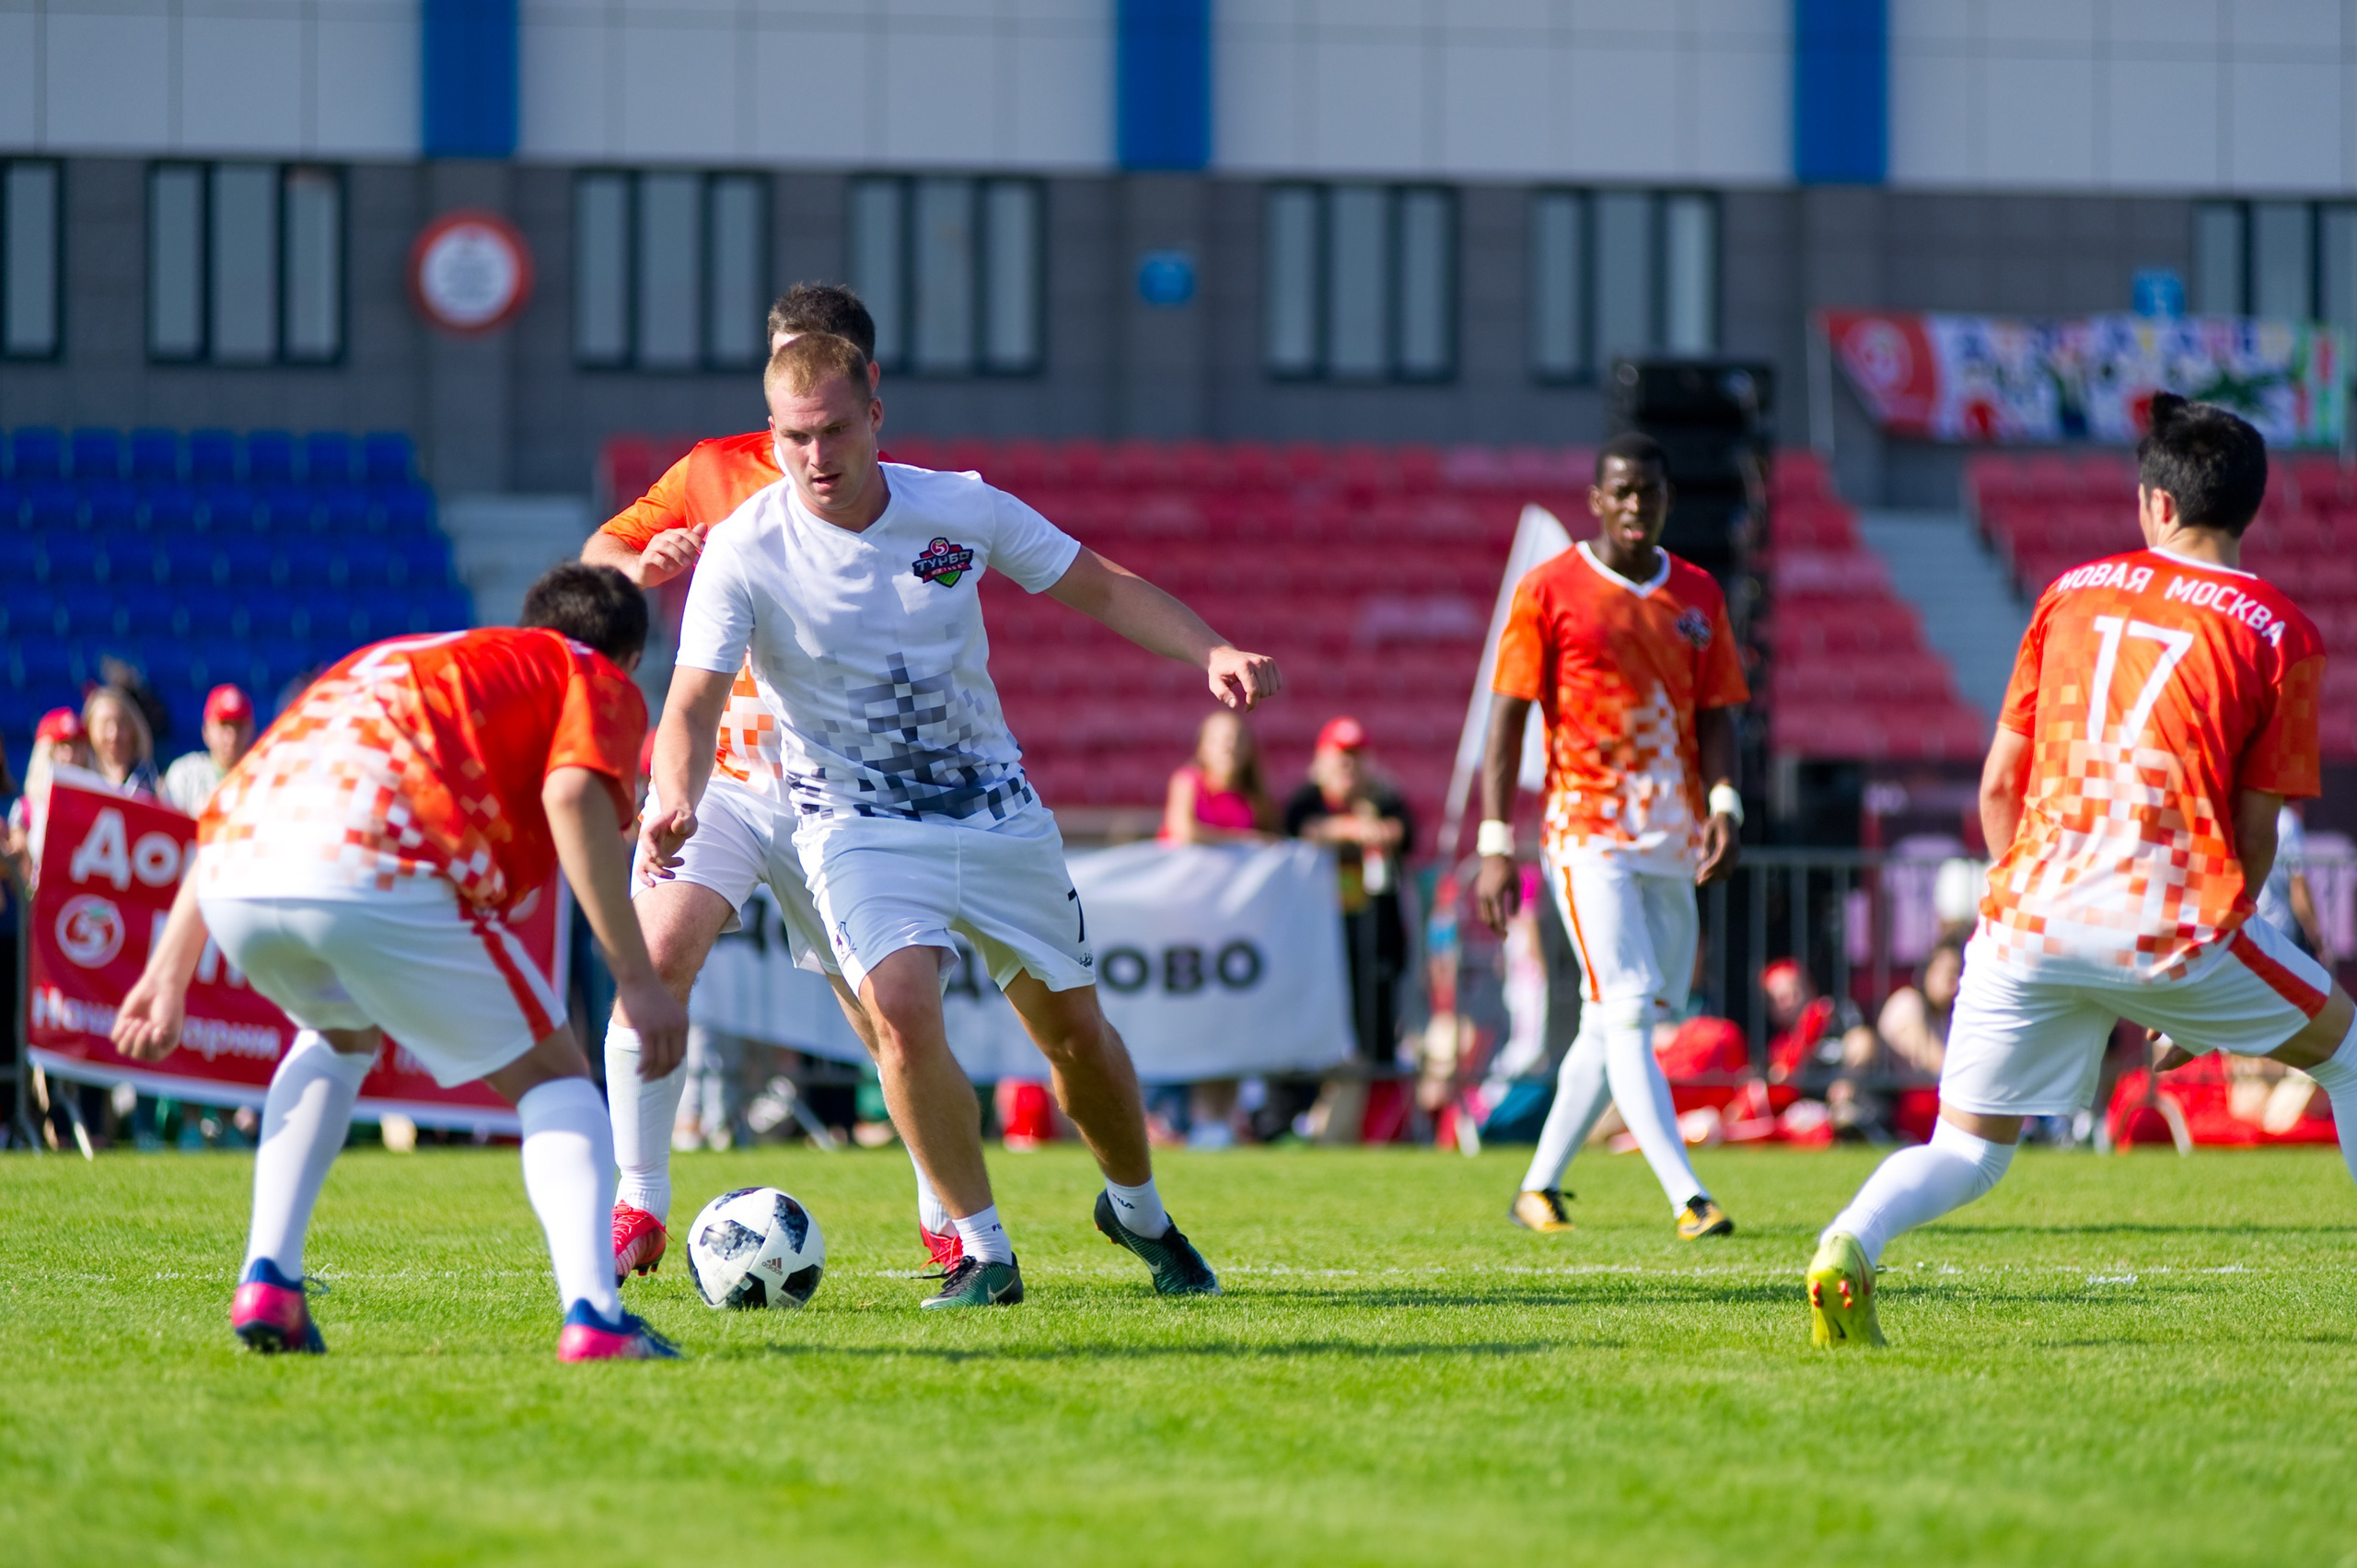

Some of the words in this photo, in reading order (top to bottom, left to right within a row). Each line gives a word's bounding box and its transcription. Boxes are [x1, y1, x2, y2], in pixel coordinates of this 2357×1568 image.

[916, 552, 970, 572] ТУРБО
[2057, 563, 2154, 594] НОВАЯ
[2165, 575, 2286, 647] МОСКВА
[2087, 615, 2194, 749] 17
[761, 1261, 784, 1276] adidas
